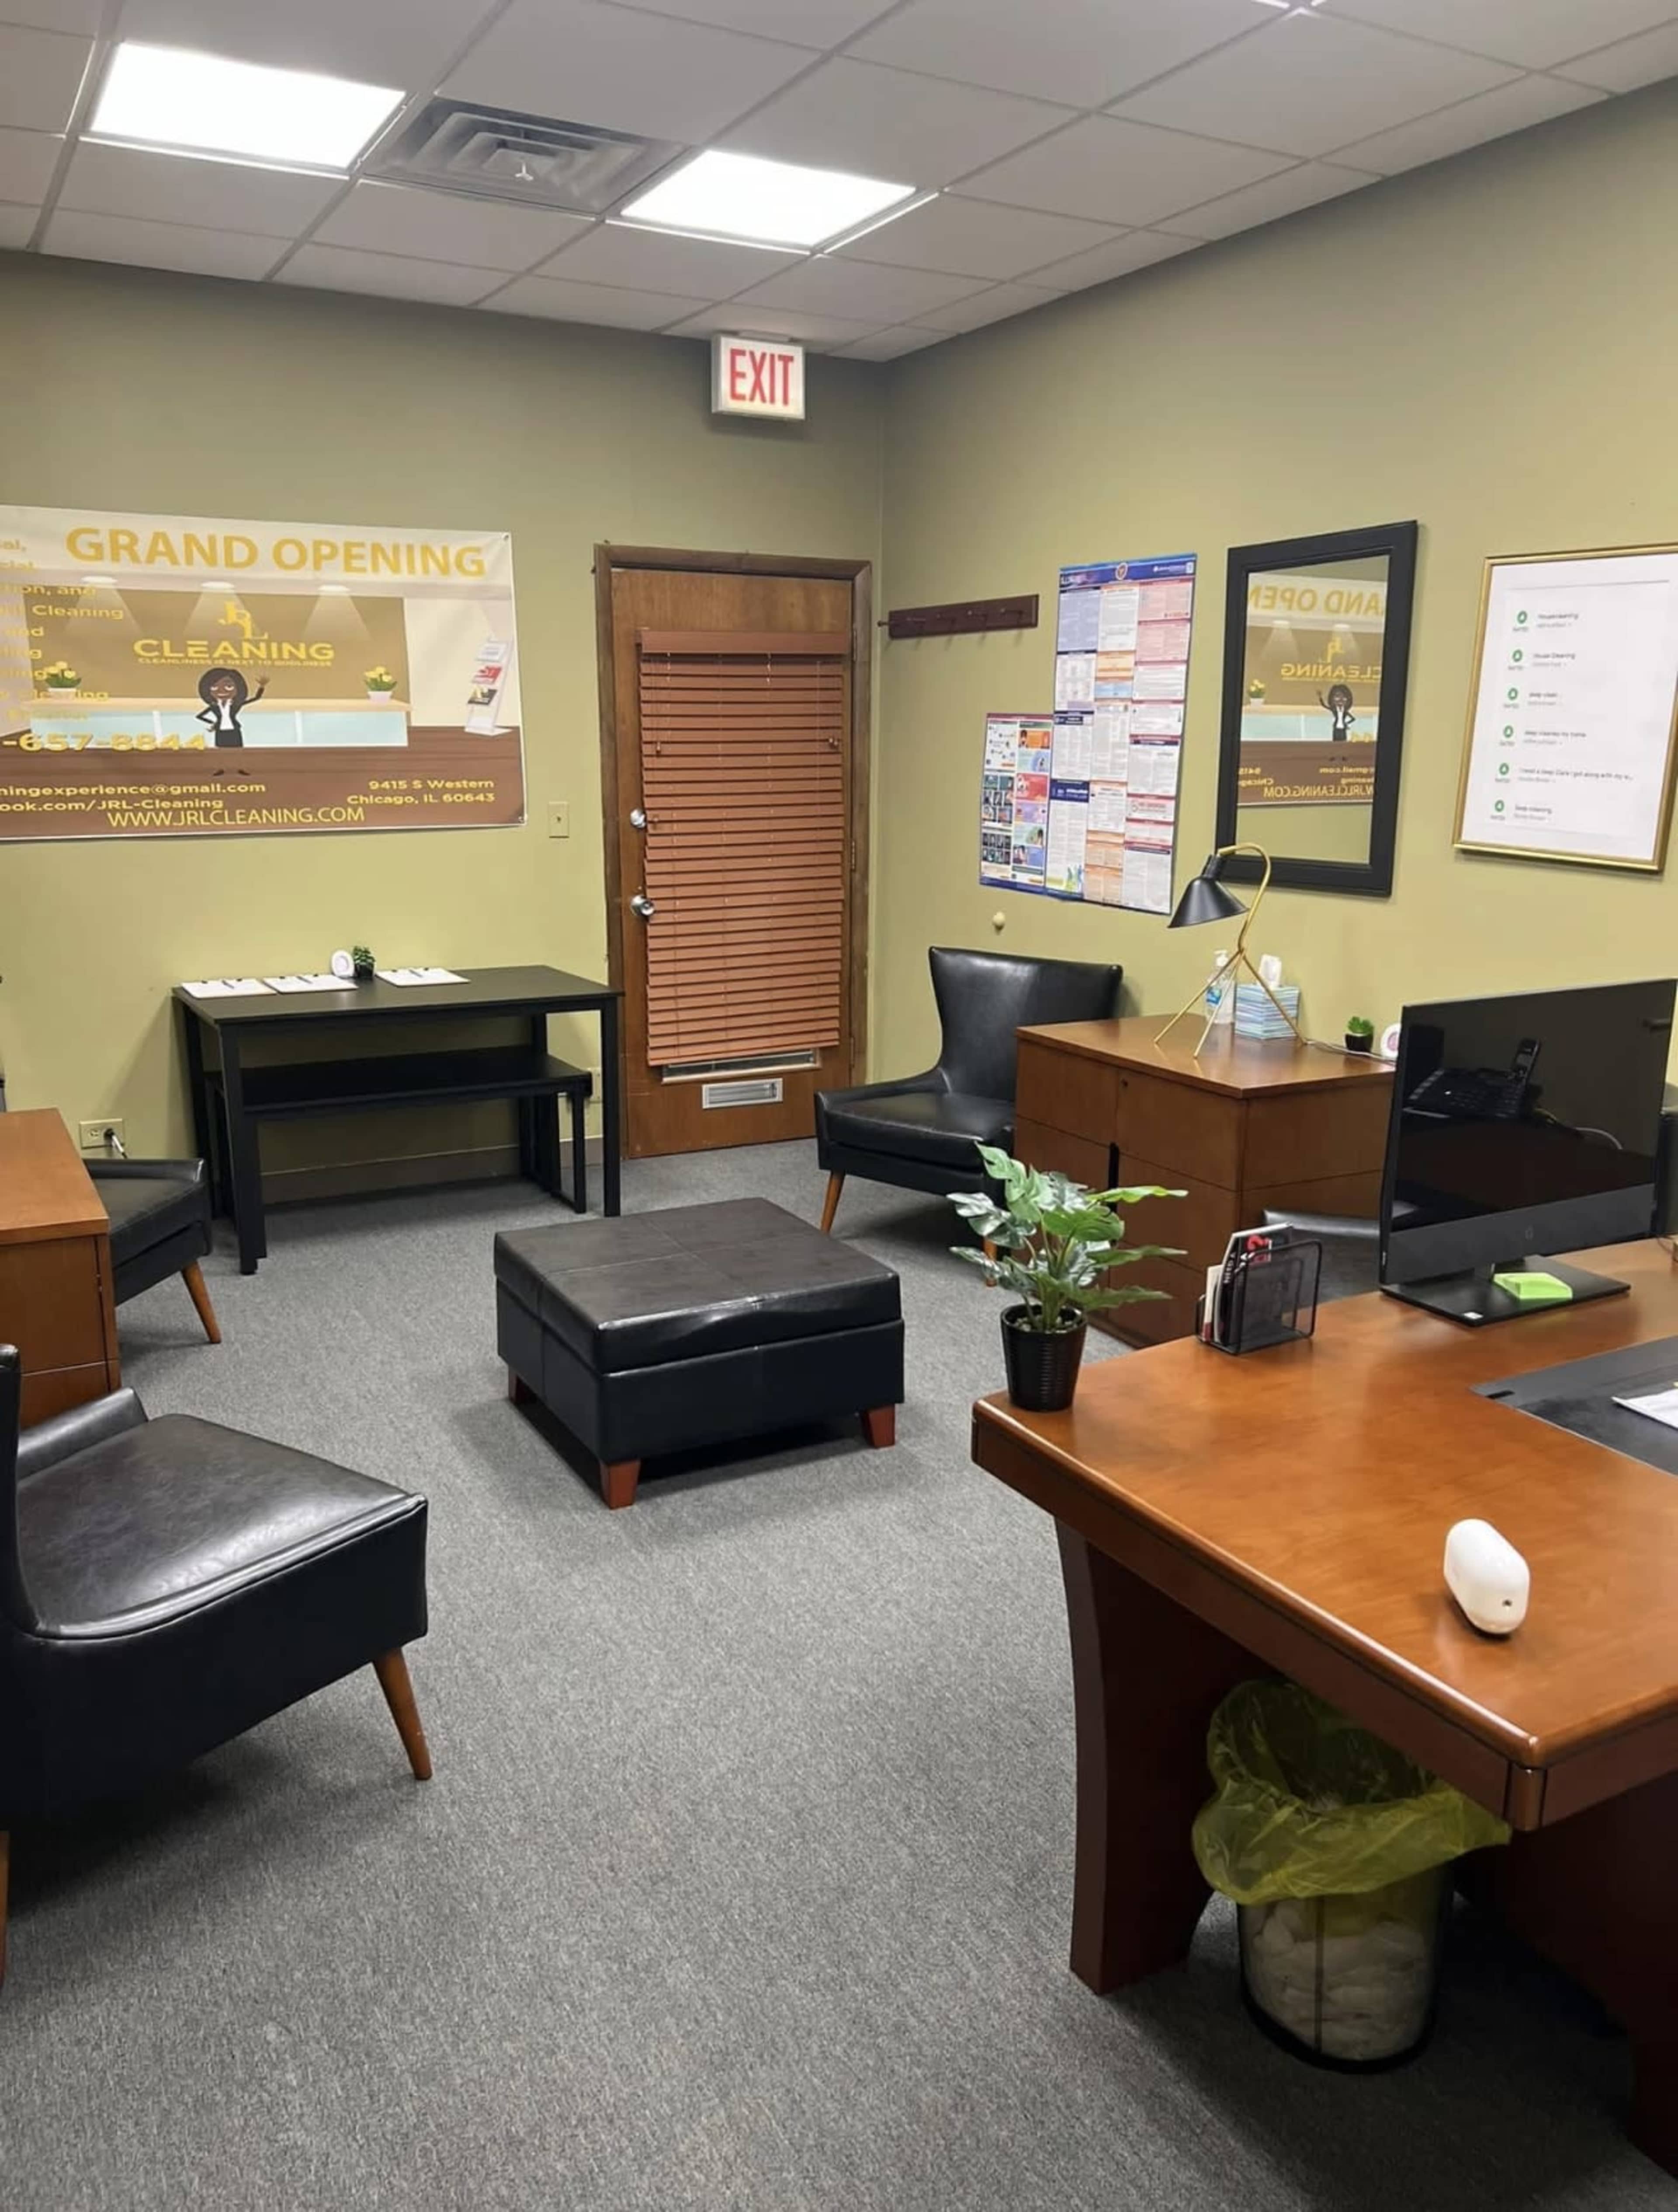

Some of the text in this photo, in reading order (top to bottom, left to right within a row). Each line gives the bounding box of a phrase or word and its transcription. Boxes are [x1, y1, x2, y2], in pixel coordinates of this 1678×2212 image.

[730, 348, 794, 406] EXIT
[66, 527, 486, 577] GRAND OPENING
[32, 605, 123, 620] Cleaning
[133, 639, 334, 660] CLEANING
[369, 780, 494, 789] 9415 S Western
[347, 793, 495, 804] Chicago, IL 60643
[107, 807, 365, 827] WWW.JRLCLEANING.COM
